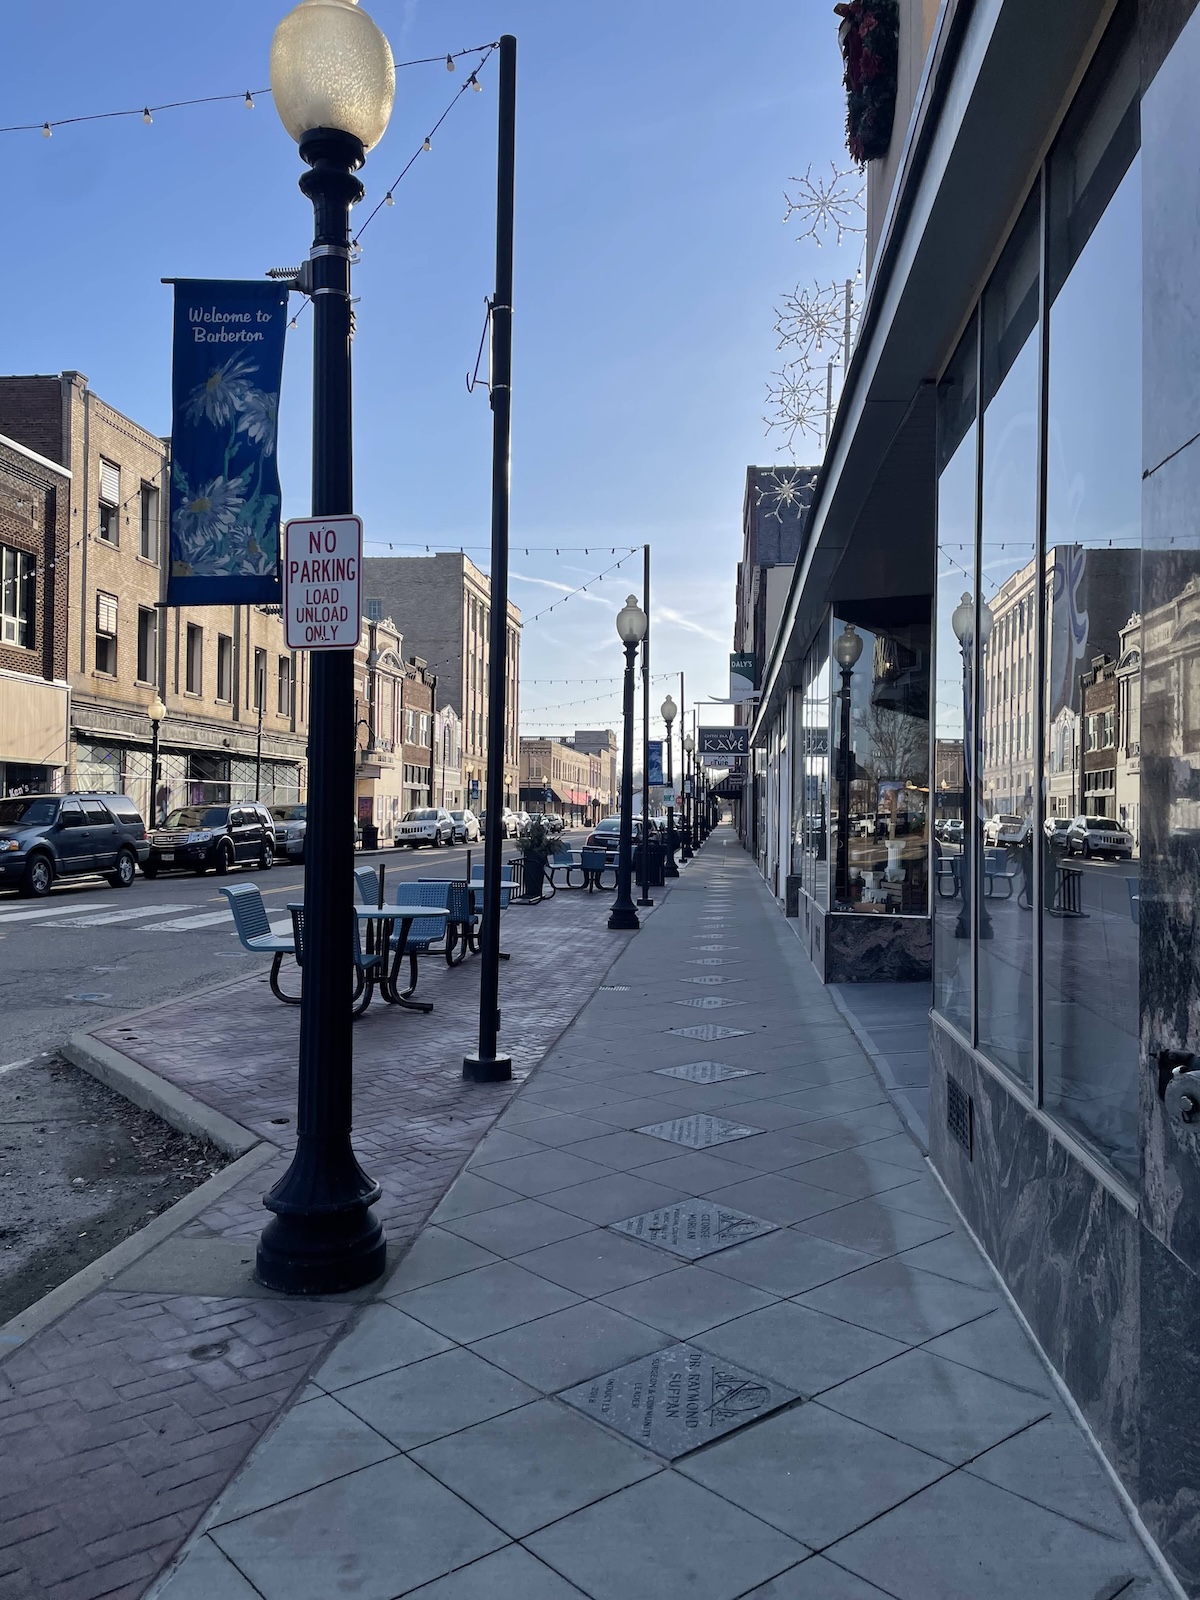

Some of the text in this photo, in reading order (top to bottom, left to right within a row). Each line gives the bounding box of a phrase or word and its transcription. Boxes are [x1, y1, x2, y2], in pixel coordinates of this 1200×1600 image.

[188, 307, 273, 324] Welcome to
[192, 326, 265, 343] Barberton
[309, 530, 337, 554] NO
[290, 557, 356, 584] PARKING
[306, 588, 339, 606] LOAD
[296, 607, 348, 624] UNLOAD
[305, 625, 338, 643] ONLY
[731, 660, 753, 668] DALY'S
[704, 736, 744, 751] KAVÉ
[8, 784, 30, 798] Ken's
[686, 1213, 697, 1240] MORGAN
[700, 1213, 711, 1240] GEORGE
[650, 1358, 659, 1387] SURGEON
[588, 1387, 599, 1404] 2018
[602, 1378, 615, 1413] INDUCTED
[630, 1382, 643, 1409] LEADER
[665, 1373, 682, 1418] SUPPAN
[685, 1354, 702, 1429] DR. RAYMOND
[642, 1395, 655, 1438] COMMUNITY
